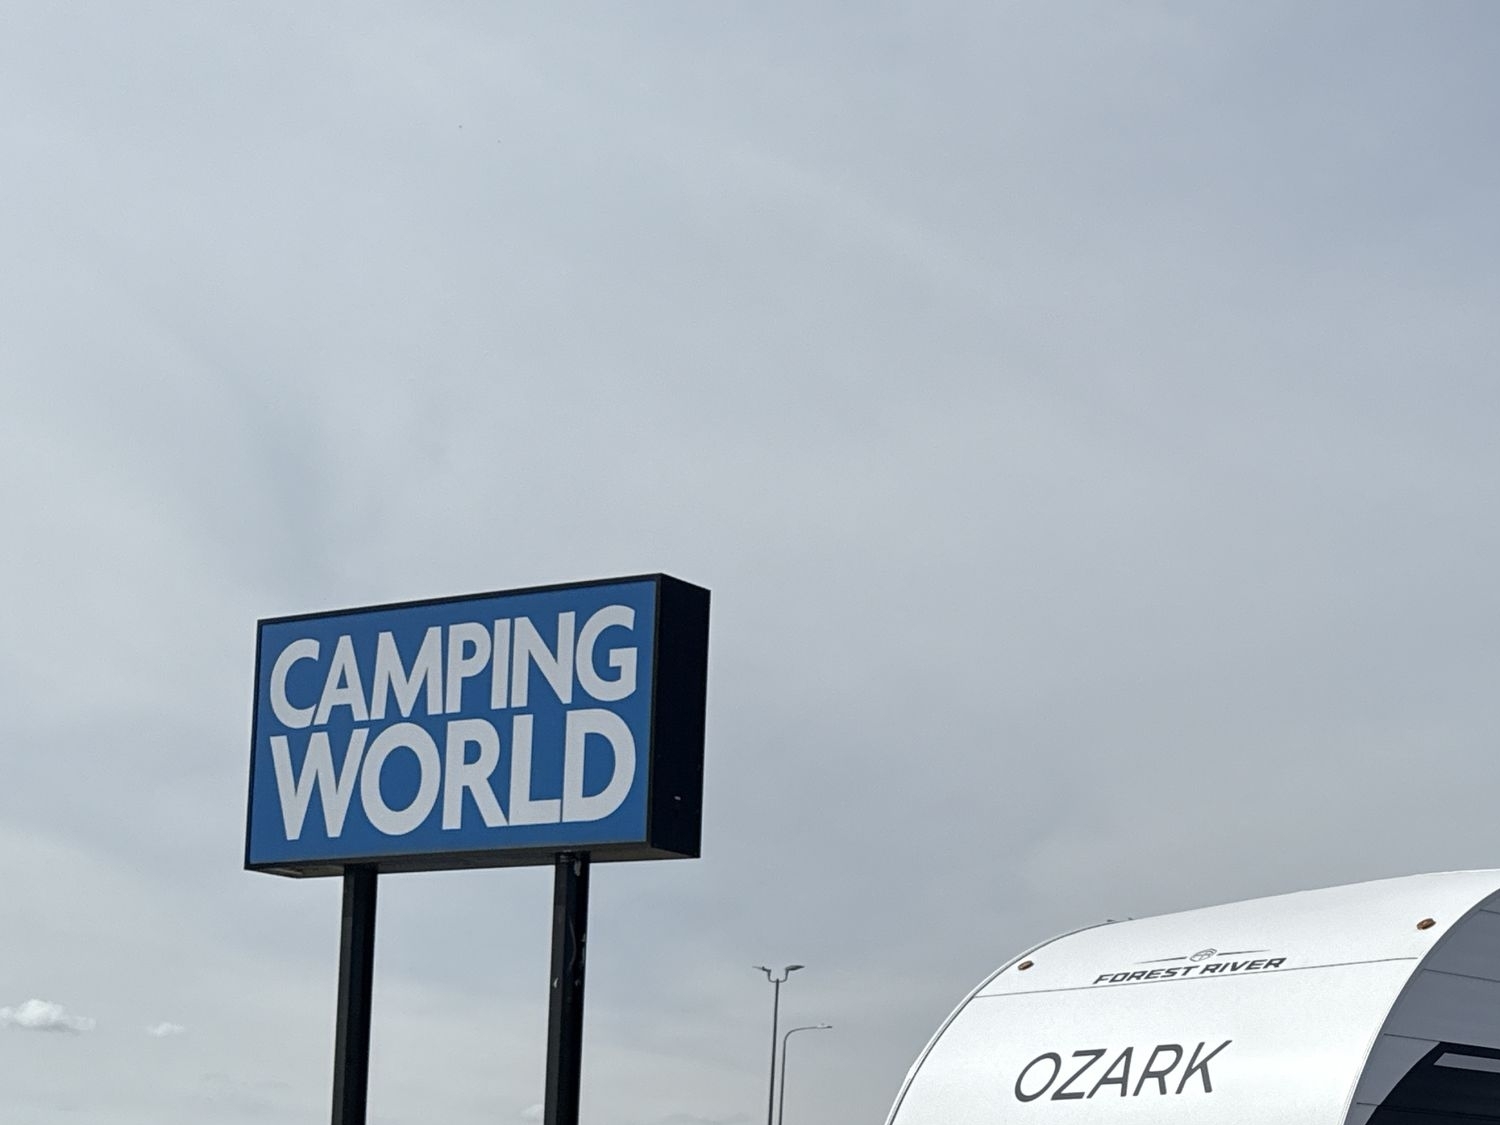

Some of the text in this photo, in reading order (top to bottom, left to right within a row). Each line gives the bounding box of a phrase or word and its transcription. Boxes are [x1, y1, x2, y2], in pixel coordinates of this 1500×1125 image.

[270, 604, 638, 729] CAMPING
[269, 708, 637, 841] WORLD
[1093, 957, 1287, 985] FOREST RIVER
[1014, 1039, 1233, 1103] OZARK
